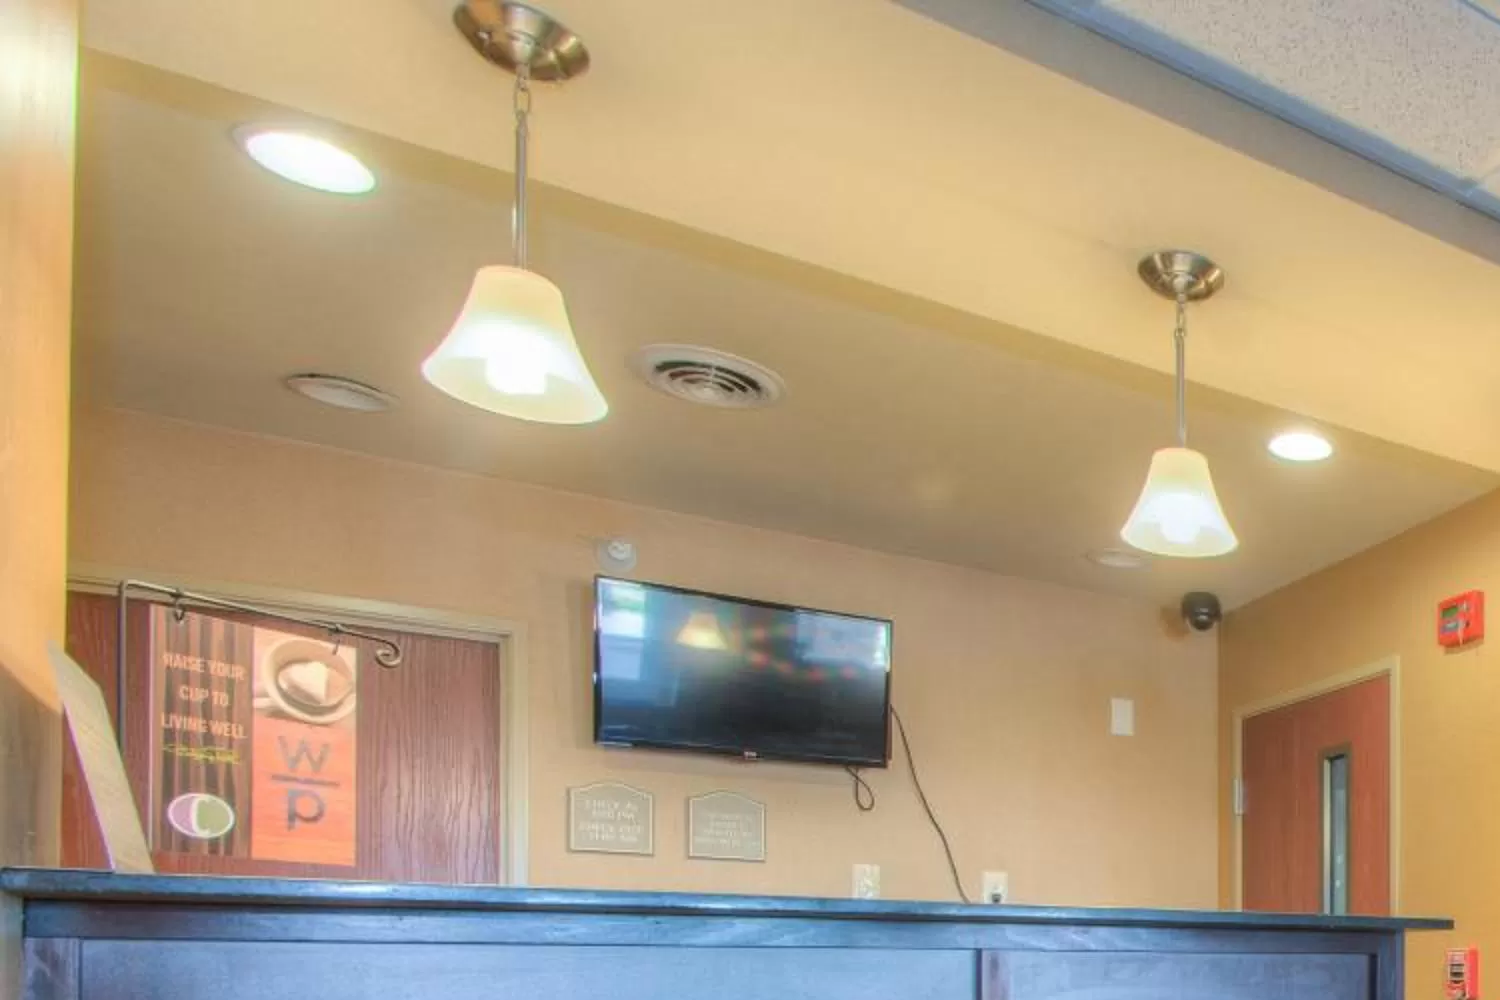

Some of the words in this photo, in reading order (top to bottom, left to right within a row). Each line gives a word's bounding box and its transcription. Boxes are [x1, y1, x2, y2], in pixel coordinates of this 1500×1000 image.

[163, 652, 205, 673] RAISE
[209, 660, 246, 681] YOUR
[180, 684, 209, 703] CUP
[212, 691, 229, 707] TO
[209, 720, 248, 739] WELL
